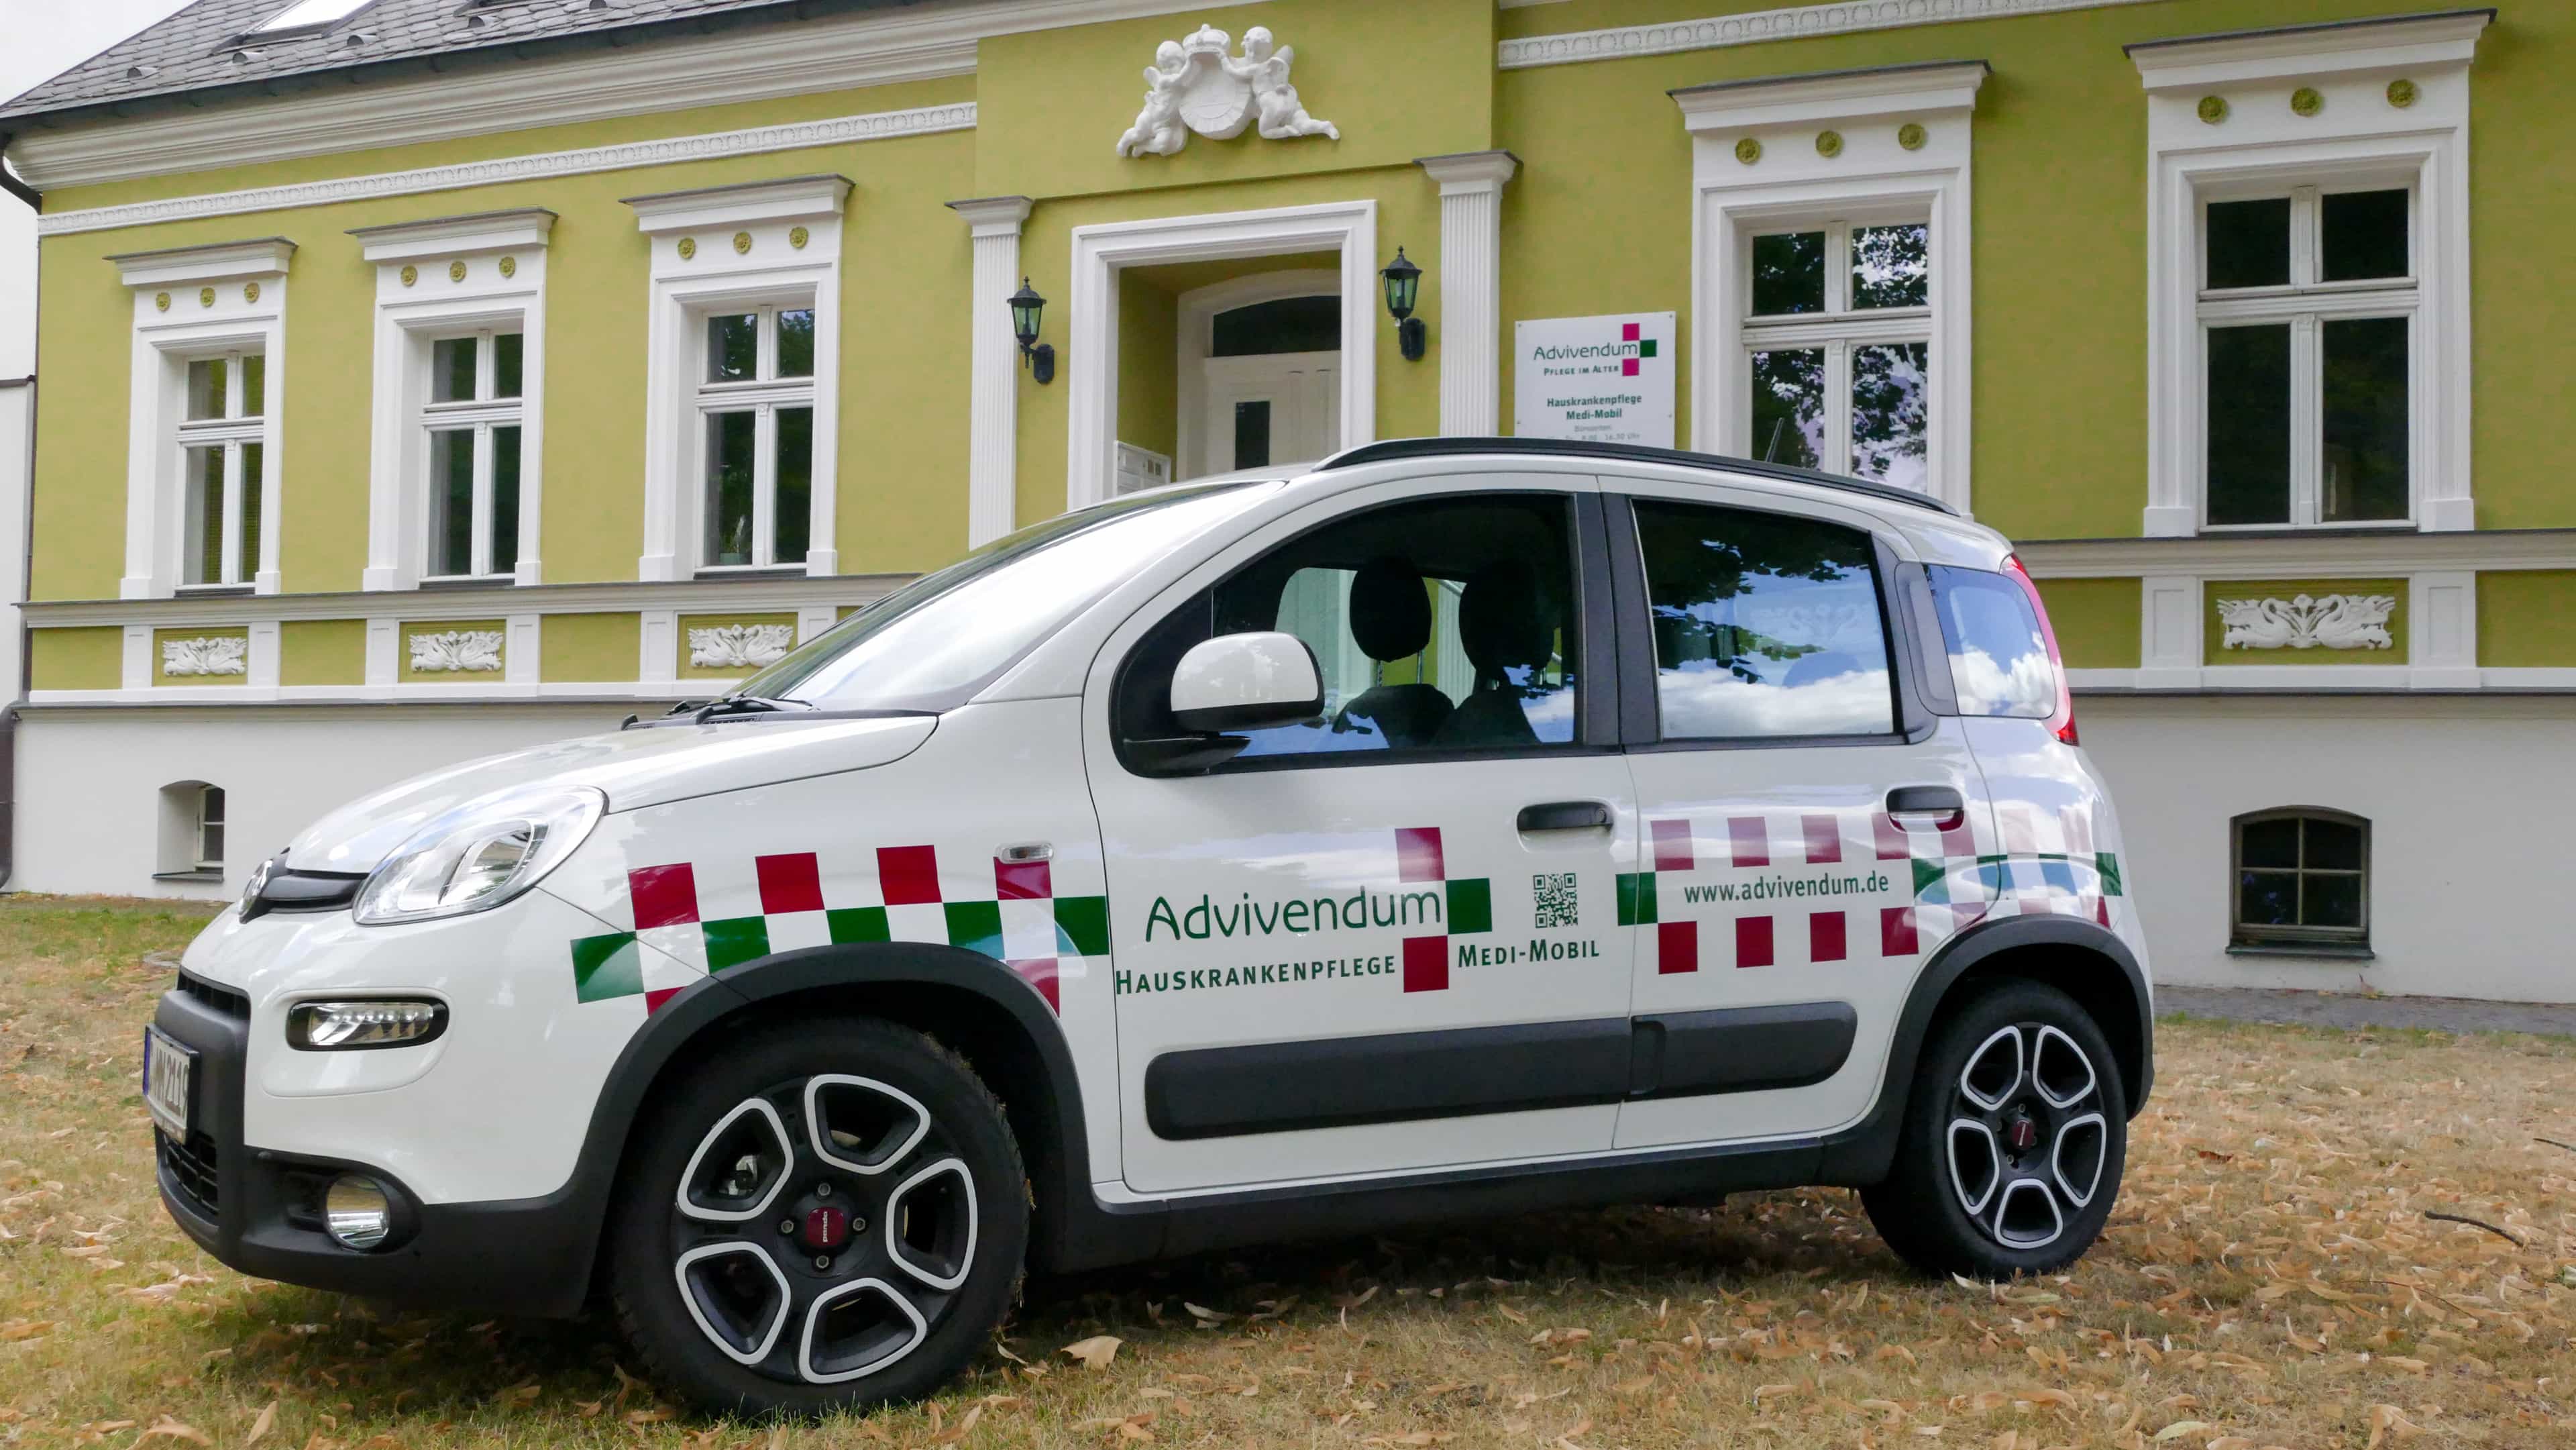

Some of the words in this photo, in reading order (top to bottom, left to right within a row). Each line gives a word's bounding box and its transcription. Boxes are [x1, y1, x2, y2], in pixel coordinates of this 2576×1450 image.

[1534, 343, 1638, 360] Advivendum
[1547, 395, 1642, 407] Hauskrankenpflege
[1566, 408, 1622, 419] Medi-Mobil
[1684, 871, 1889, 903] www.advivendum.de
[1145, 886, 1441, 942] Advivendum
[1458, 940, 1600, 968] MEDI-MOBIL
[1116, 955, 1396, 995] HAUSKRANKENPFLEGE
